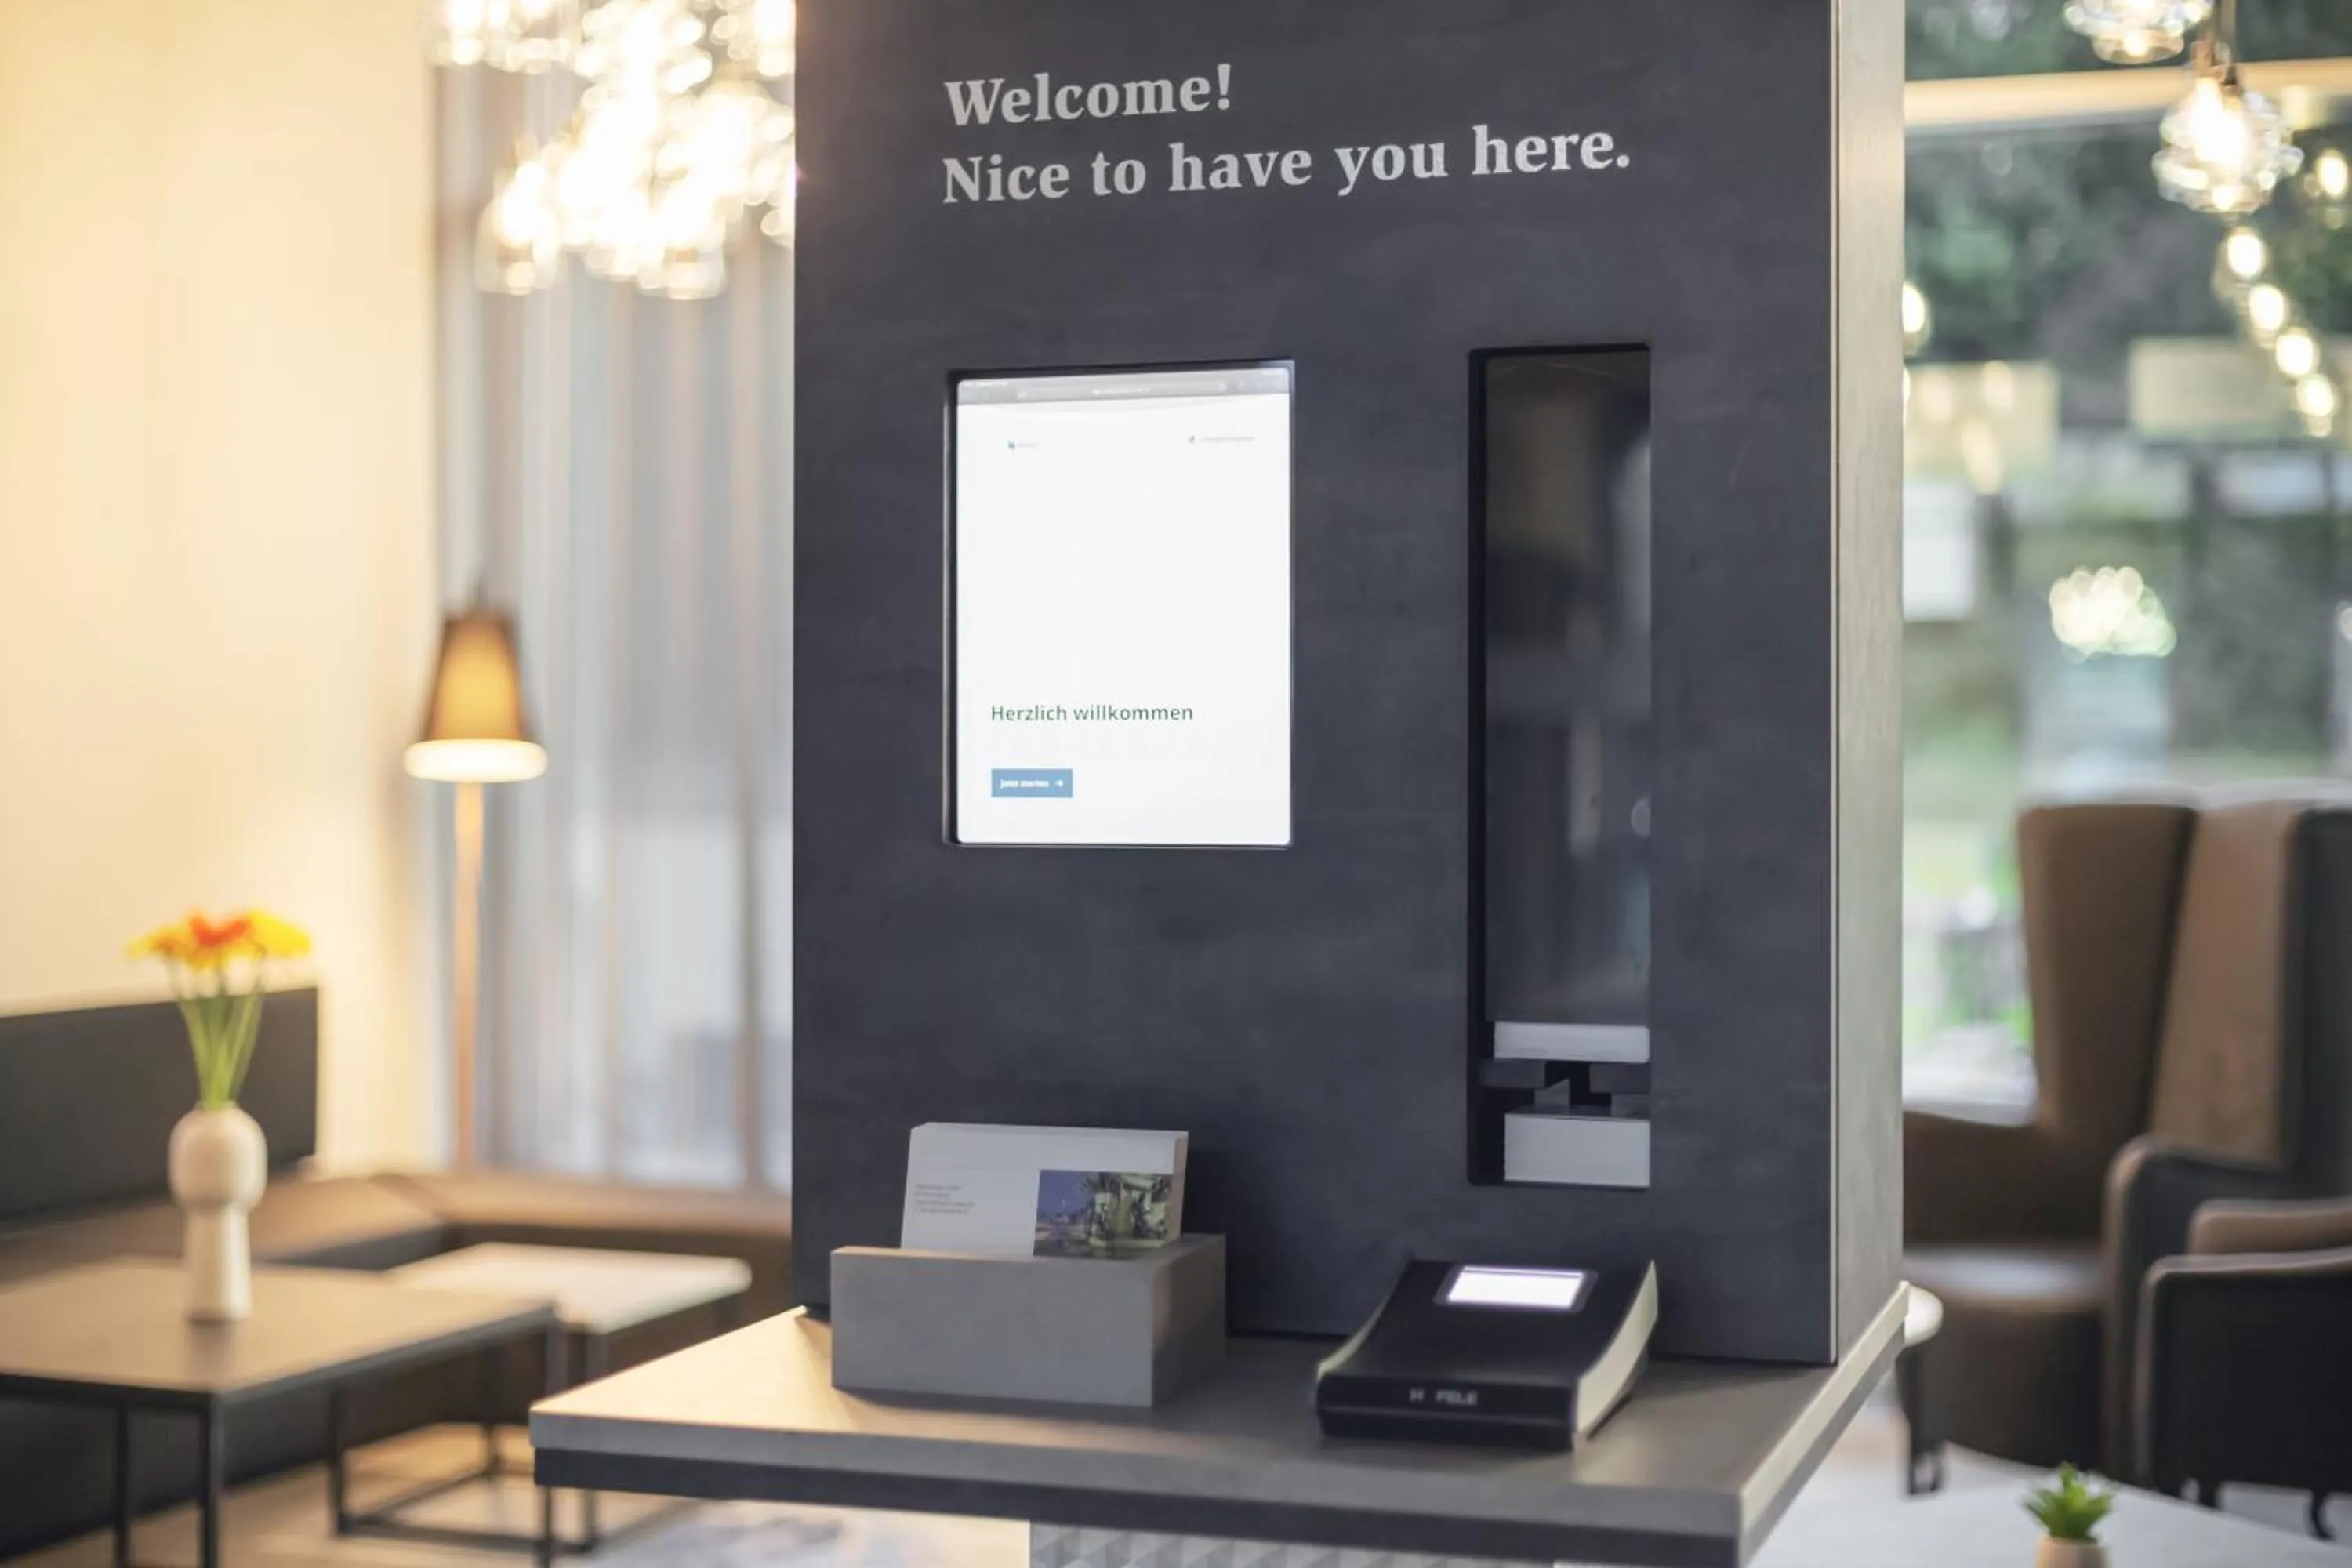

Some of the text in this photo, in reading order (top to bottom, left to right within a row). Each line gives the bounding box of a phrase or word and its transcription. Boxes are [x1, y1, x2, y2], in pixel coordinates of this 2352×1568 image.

[943, 63, 1231, 126] Welcome!
[942, 124, 1631, 204] Nice to have you here.
[991, 704, 1193, 721] Herzlich willkommen
